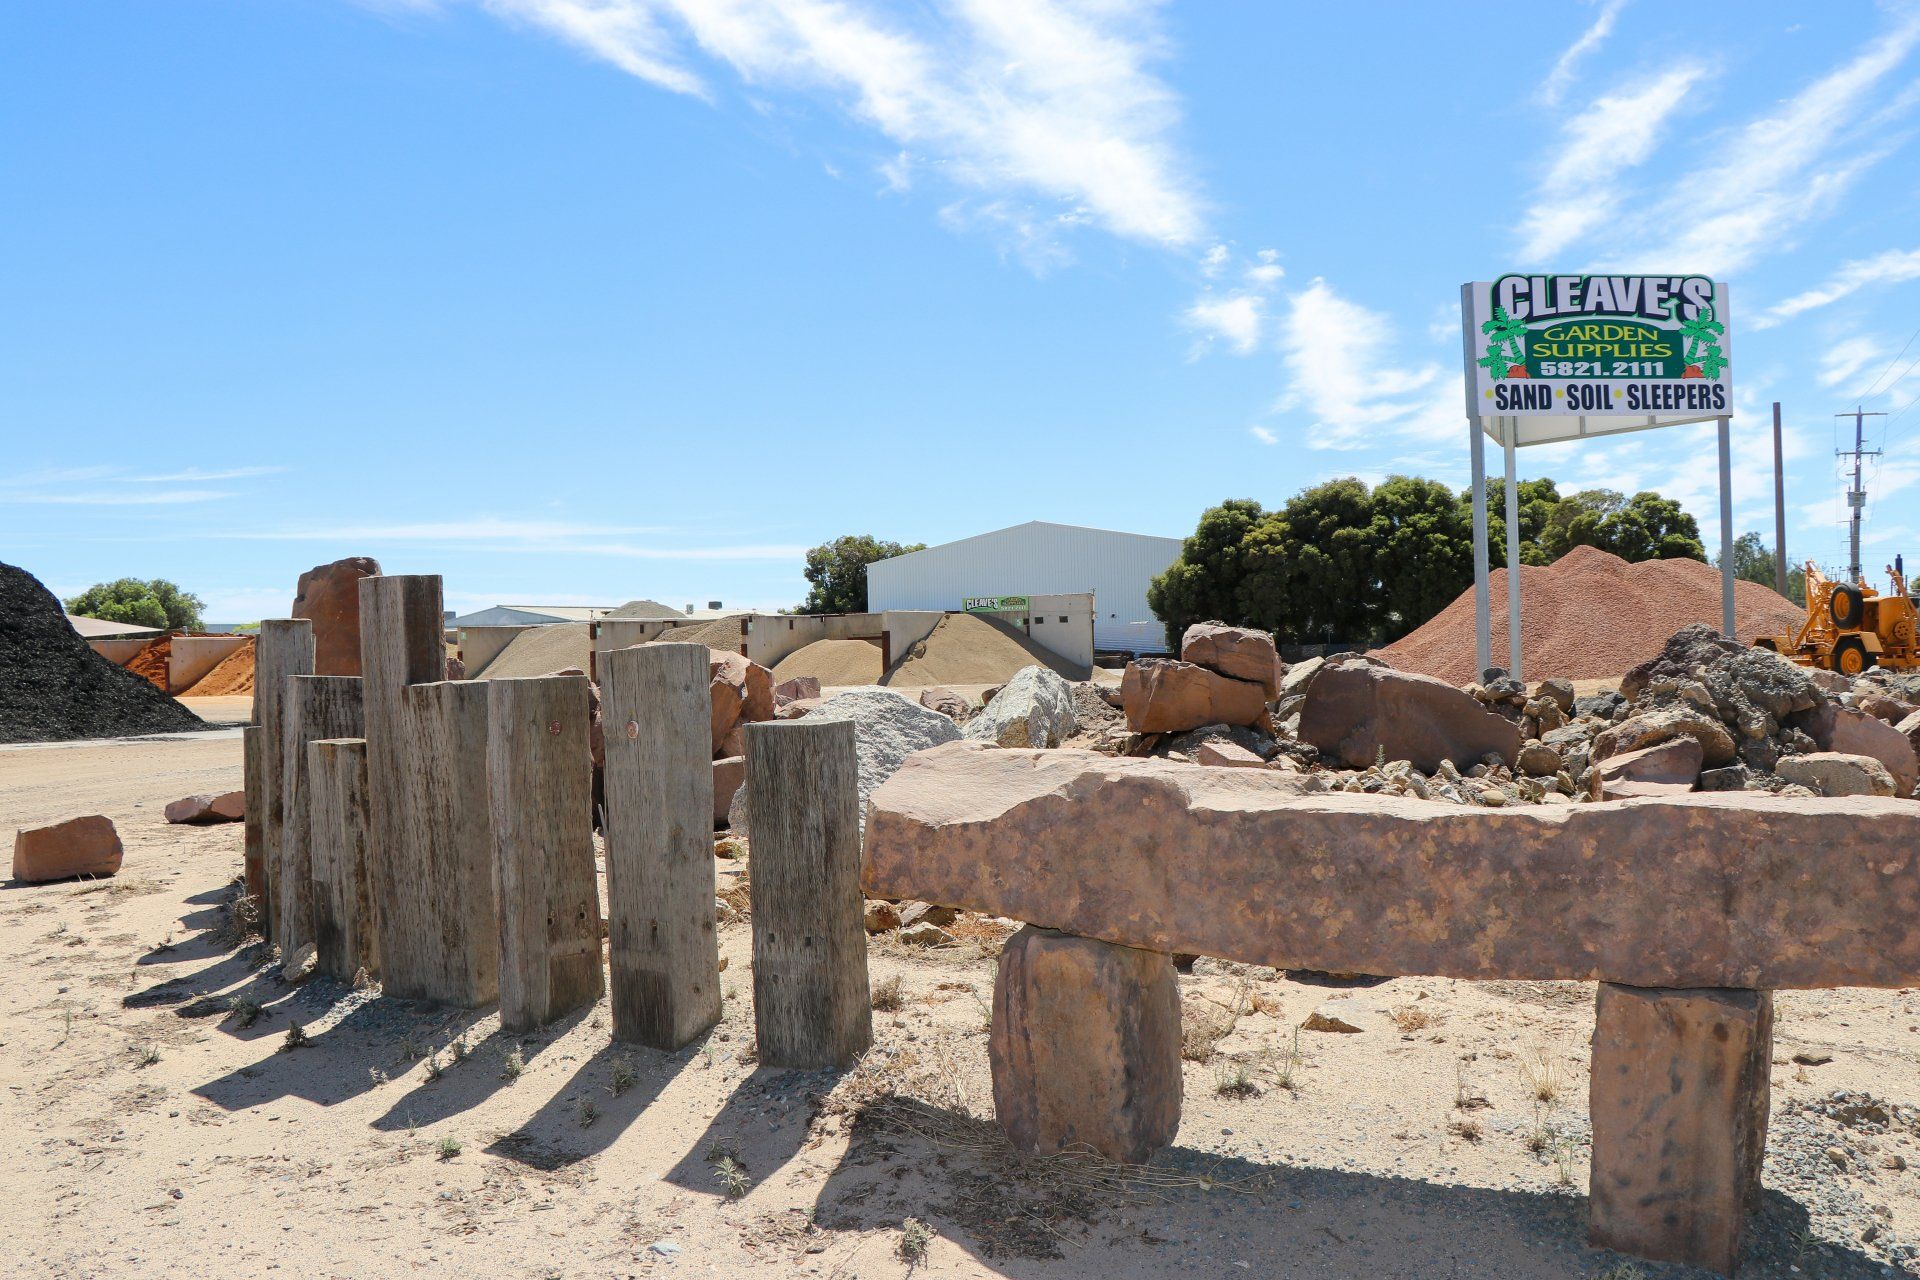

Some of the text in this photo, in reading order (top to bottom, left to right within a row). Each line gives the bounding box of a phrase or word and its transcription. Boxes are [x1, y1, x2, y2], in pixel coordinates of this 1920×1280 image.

[1496, 275, 1714, 322] CLEAVE'S
[1543, 324, 1659, 341] GARDEN
[1532, 343, 1673, 358] SUPPLIES
[1540, 361, 1664, 376] 5821.2111
[1495, 383, 1726, 410] SAND SOIL SLEEPERS
[966, 598, 998, 610] CLEAVE'S
